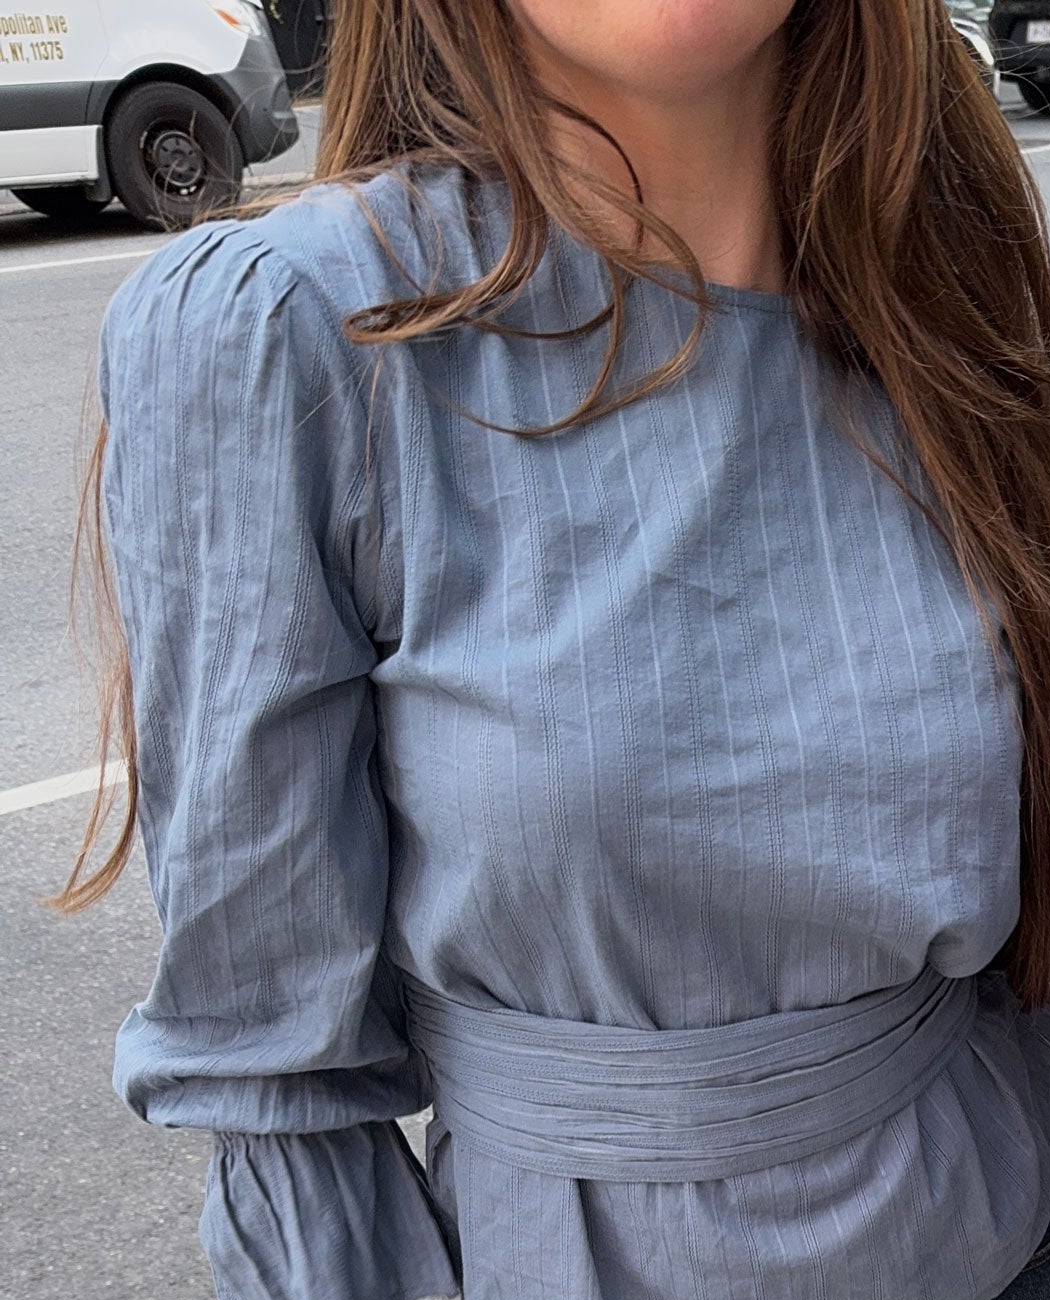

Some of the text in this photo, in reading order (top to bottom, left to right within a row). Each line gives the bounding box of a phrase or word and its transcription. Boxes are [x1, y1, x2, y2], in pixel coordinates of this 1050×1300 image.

[0, 13, 67, 36] politan Ave
[9, 42, 29, 64] NY,
[30, 41, 64, 61] 11375
